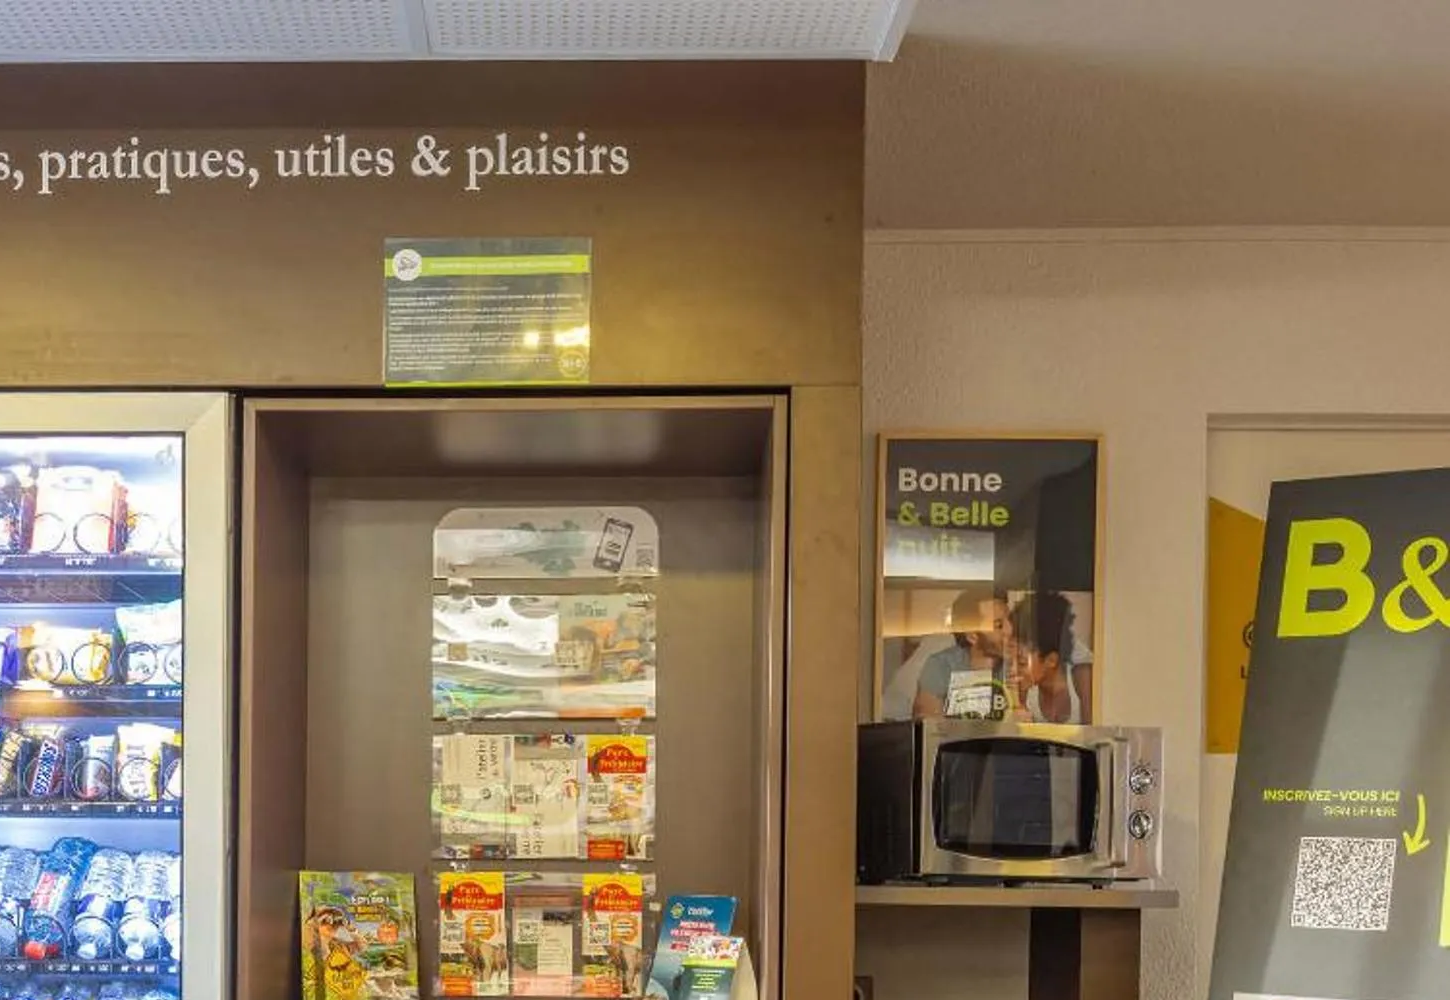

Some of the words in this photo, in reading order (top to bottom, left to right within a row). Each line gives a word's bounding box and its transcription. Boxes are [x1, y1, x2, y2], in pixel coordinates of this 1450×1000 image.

[37, 136, 261, 194] pratiques,
[275, 133, 395, 177] utiles
[411, 134, 451, 177] &
[464, 131, 630, 191] plaisirs
[897, 467, 1003, 493] Bonne
[897, 502, 920, 526] &
[930, 500, 1010, 527] Belle
[1263, 789, 1381, 802] INSCRIVEZ-VOUS
[1381, 790, 1400, 802] ICI
